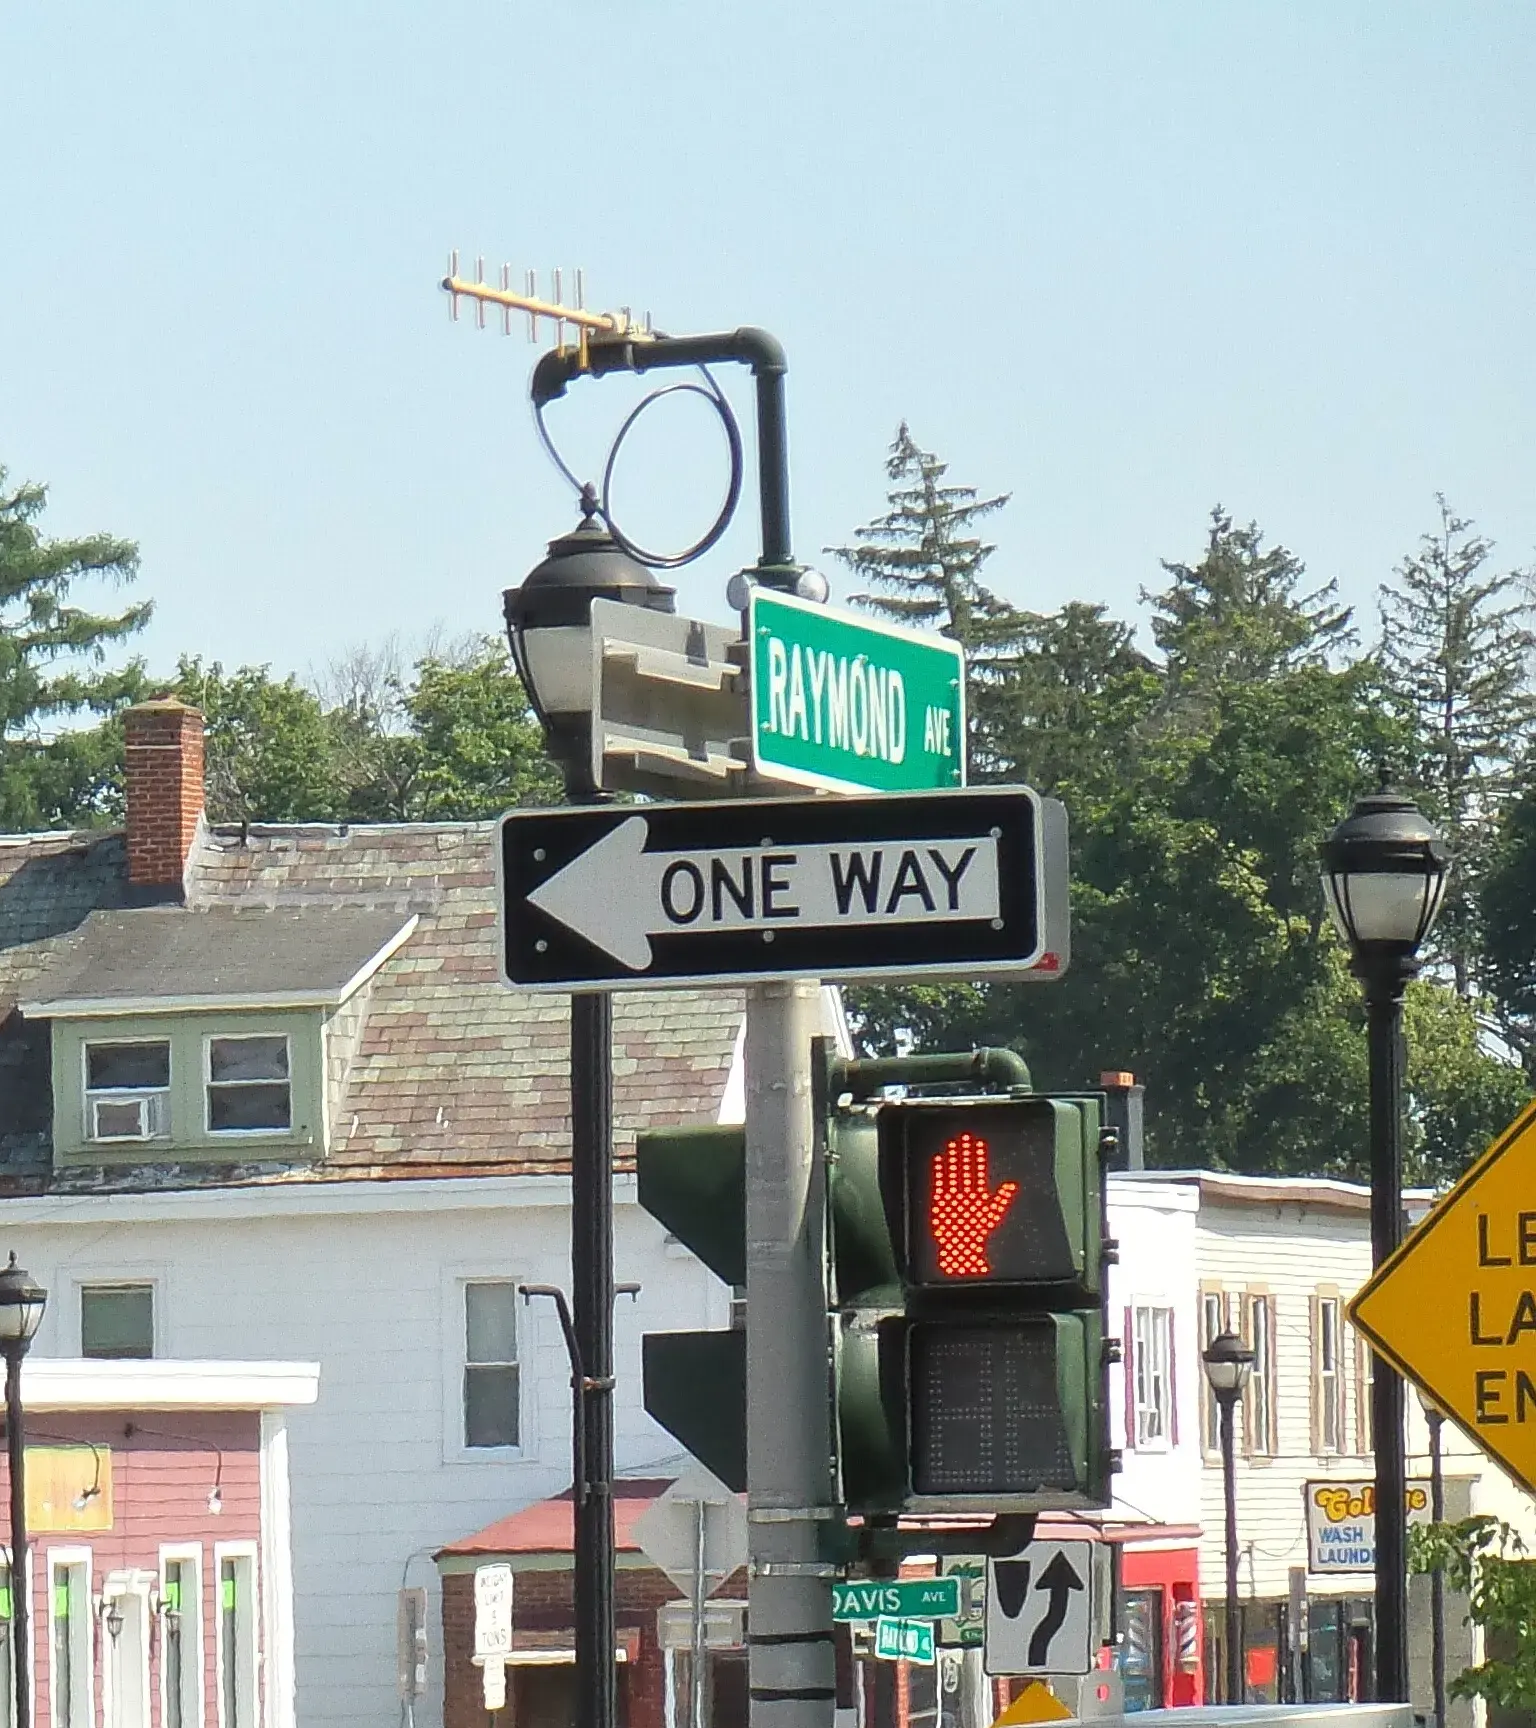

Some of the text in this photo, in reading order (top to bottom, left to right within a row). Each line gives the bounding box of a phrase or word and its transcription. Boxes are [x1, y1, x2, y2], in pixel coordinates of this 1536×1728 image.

[769, 637, 952, 764] RAYMOND AVE
[661, 847, 977, 924] ONE WAY
[1318, 1526, 1364, 1543] WASH
[1317, 1547, 1376, 1565] LAUND
[921, 1591, 946, 1604] AVE
